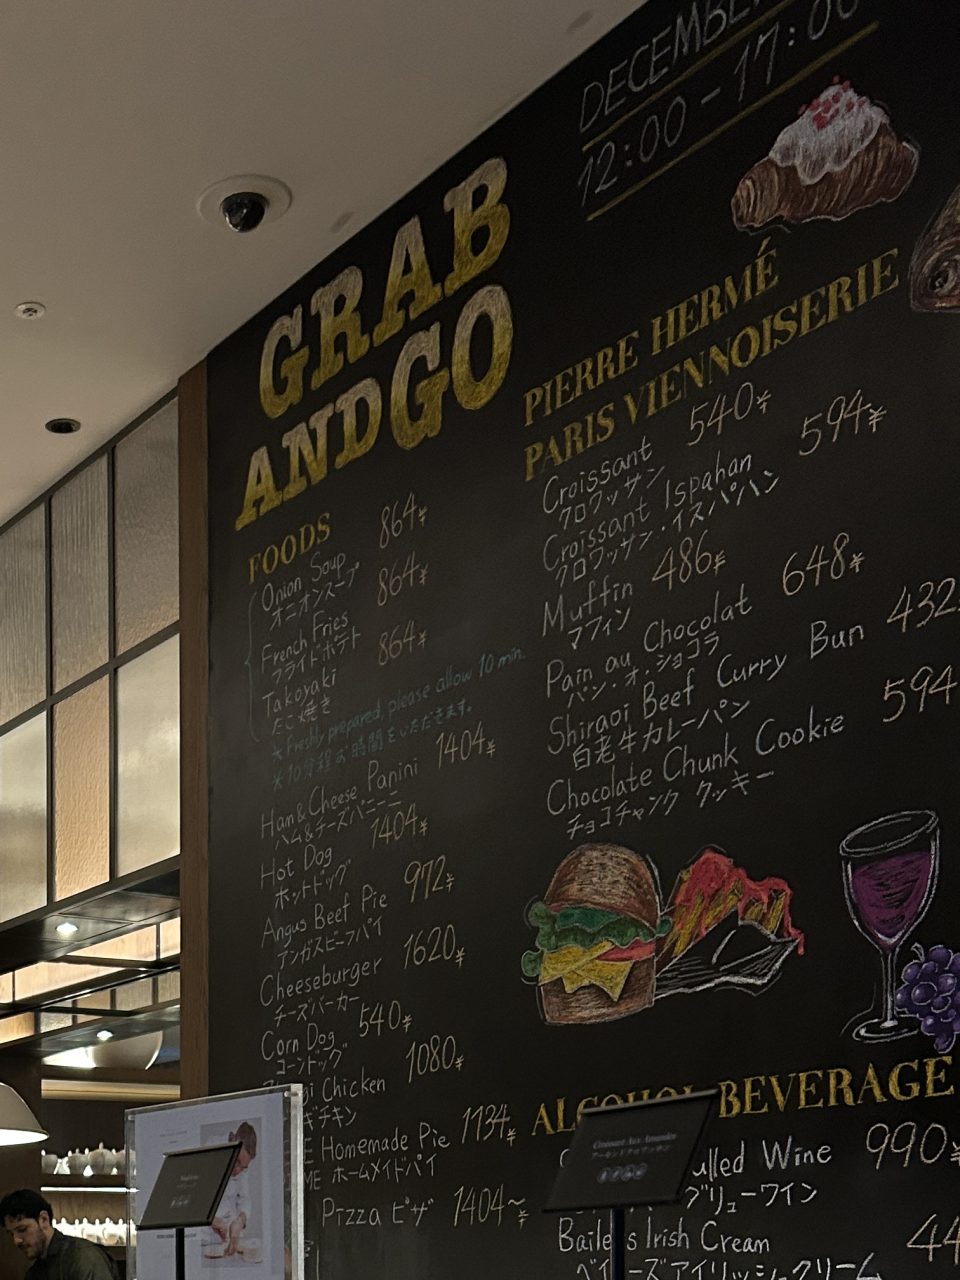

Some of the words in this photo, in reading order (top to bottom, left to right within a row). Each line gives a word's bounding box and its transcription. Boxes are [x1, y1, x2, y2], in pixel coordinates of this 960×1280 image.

[576, 96, 687, 206] 12:00
[260, 155, 511, 418] GRAB
[524, 328, 640, 427] PIERRE
[651, 238, 779, 357] HERMÉ
[524, 402, 616, 481] PARIS
[624, 248, 901, 425] VIENNOISERIE
[542, 436, 652, 514] Croissant
[559, 465, 666, 530] クロワッサン
[543, 497, 651, 571] Croissant
[665, 451, 752, 510] Ispahan
[248, 511, 331, 584] FOODS
[261, 577, 302, 611] Onion
[310, 551, 346, 582] Soup
[542, 576, 633, 637] Muffin
[261, 629, 307, 674] French
[313, 611, 349, 643] Fries
[547, 659, 593, 698] Pain
[606, 651, 632, 673] au
[644, 583, 752, 652] Chocolat
[569, 608, 631, 650] マフィン
[643, 668, 695, 720] Beef
[717, 650, 787, 689] Curry
[810, 620, 865, 661] Bun
[887, 577, 960, 633] 432
[262, 666, 336, 719] Takoyaki
[388, 685, 430, 717] please
[436, 665, 472, 693] allow
[547, 764, 652, 816] Chocolate
[663, 732, 738, 782] Chunk
[755, 705, 845, 756] Cookie
[883, 665, 959, 723] 594
[368, 759, 420, 793] Panini
[260, 856, 295, 889] Hot
[305, 843, 332, 871] Dog
[261, 917, 307, 949] Angus
[314, 891, 351, 930] Beef
[361, 883, 389, 913] Pie
[260, 957, 383, 1007] Cheeseburger
[261, 1030, 299, 1061] Corn
[307, 1022, 335, 1051] Dog
[322, 1066, 386, 1102] Chicken
[718, 1055, 954, 1119] BEVERAGE
[322, 1126, 409, 1162] Homemade
[419, 1121, 451, 1150] Pie
[692, 1140, 744, 1181] ulled
[762, 1134, 832, 1169] Wine
[322, 1196, 381, 1228] Pizza
[392, 1196, 435, 1228] ピザ
[558, 1216, 638, 1253] Bailes
[646, 1214, 690, 1251] Irish
[700, 1221, 771, 1254] Cream
